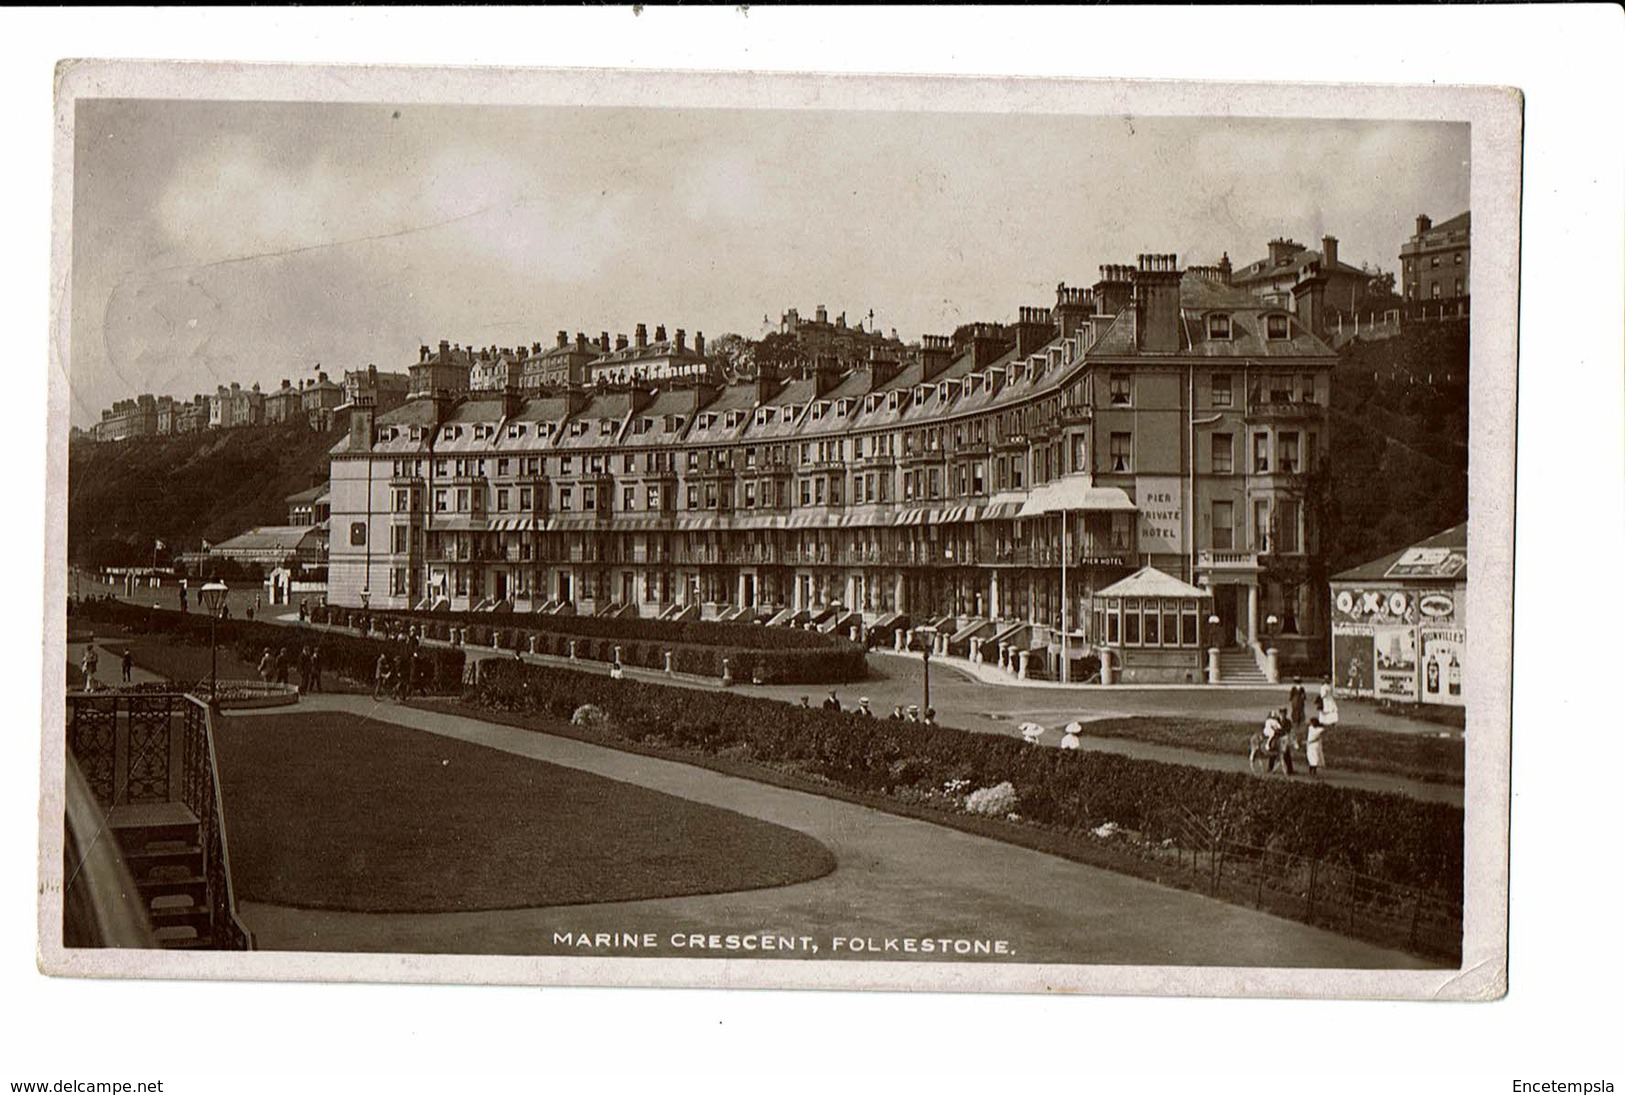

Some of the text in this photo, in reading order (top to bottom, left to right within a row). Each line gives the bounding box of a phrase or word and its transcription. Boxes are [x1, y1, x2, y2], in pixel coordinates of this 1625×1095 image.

[1147, 493, 1171, 503] PIER
[1142, 528, 1176, 539] HOTEL
[1082, 557, 1123, 566] PIER HOTEL
